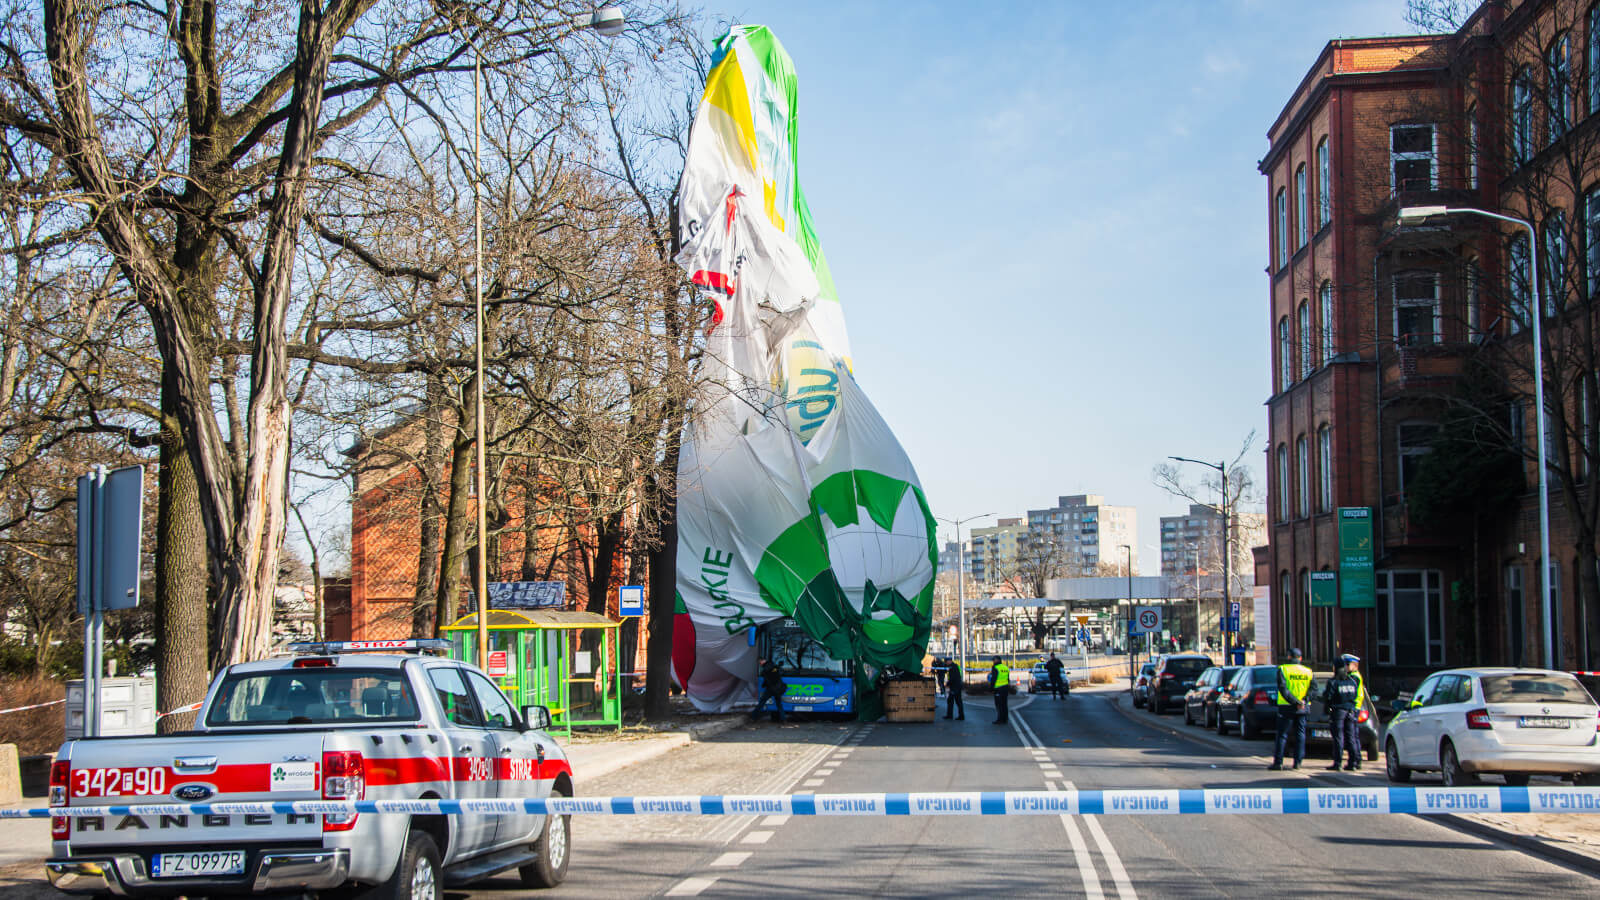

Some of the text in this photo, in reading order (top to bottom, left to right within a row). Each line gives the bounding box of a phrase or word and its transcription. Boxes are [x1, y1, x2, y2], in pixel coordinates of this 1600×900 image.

[1142, 614, 1156, 624] 30
[785, 684, 824, 696] ZKP
[553, 800, 603, 812] POLICJA
[641, 800, 692, 812] POLICJA
[731, 800, 782, 812] POLICJA
[823, 799, 876, 811] POLICJA
[917, 798, 971, 811] POLICJA
[1013, 796, 1068, 810] POLICJA
[1112, 796, 1168, 810] POLICJA
[1213, 794, 1272, 809] POLICJA
[1317, 793, 1378, 808] POLICJA
[1425, 793, 1489, 808] POLICJA
[383, 802, 431, 812] POLICJA
[467, 802, 516, 812] POLICJA
[163, 855, 184, 871] FZ
[191, 852, 241, 870] 0997R
